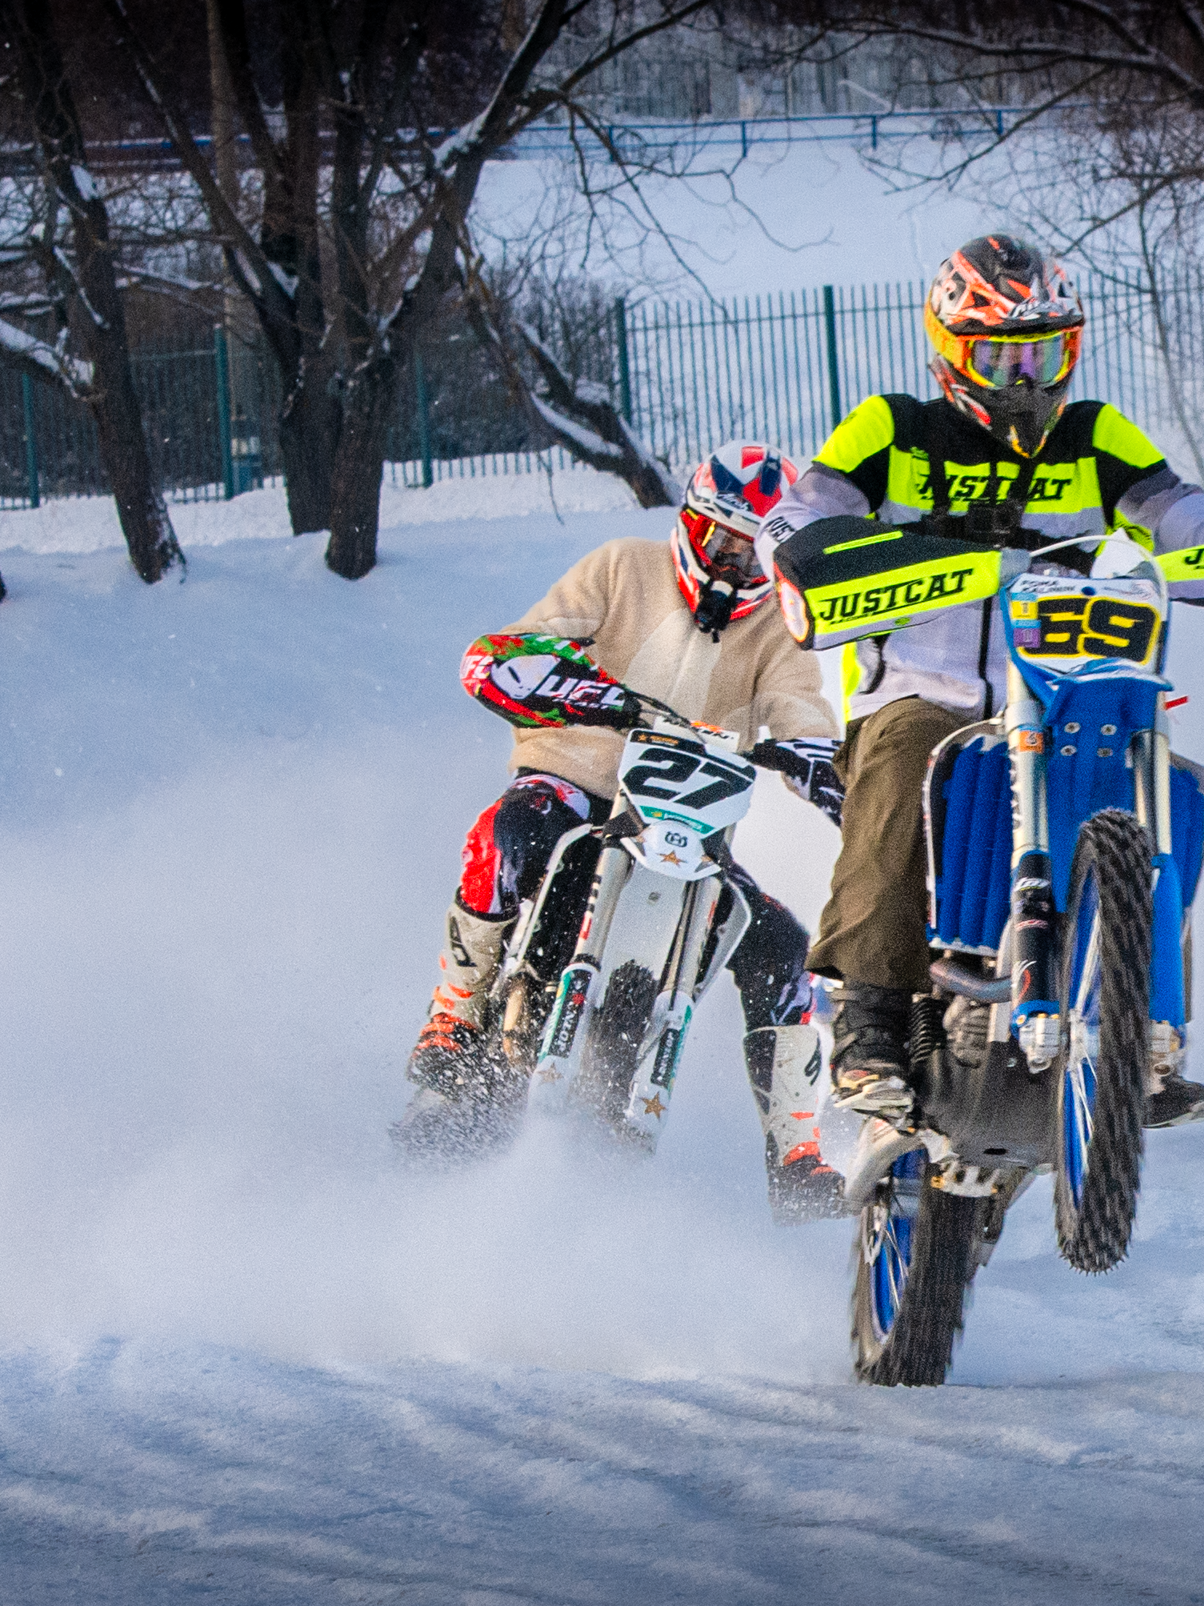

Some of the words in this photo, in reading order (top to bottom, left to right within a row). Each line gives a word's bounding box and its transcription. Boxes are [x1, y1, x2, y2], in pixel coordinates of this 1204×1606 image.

[818, 567, 975, 621] JUSTCAT
[1018, 595, 1160, 664] 69
[622, 747, 753, 811] 27
